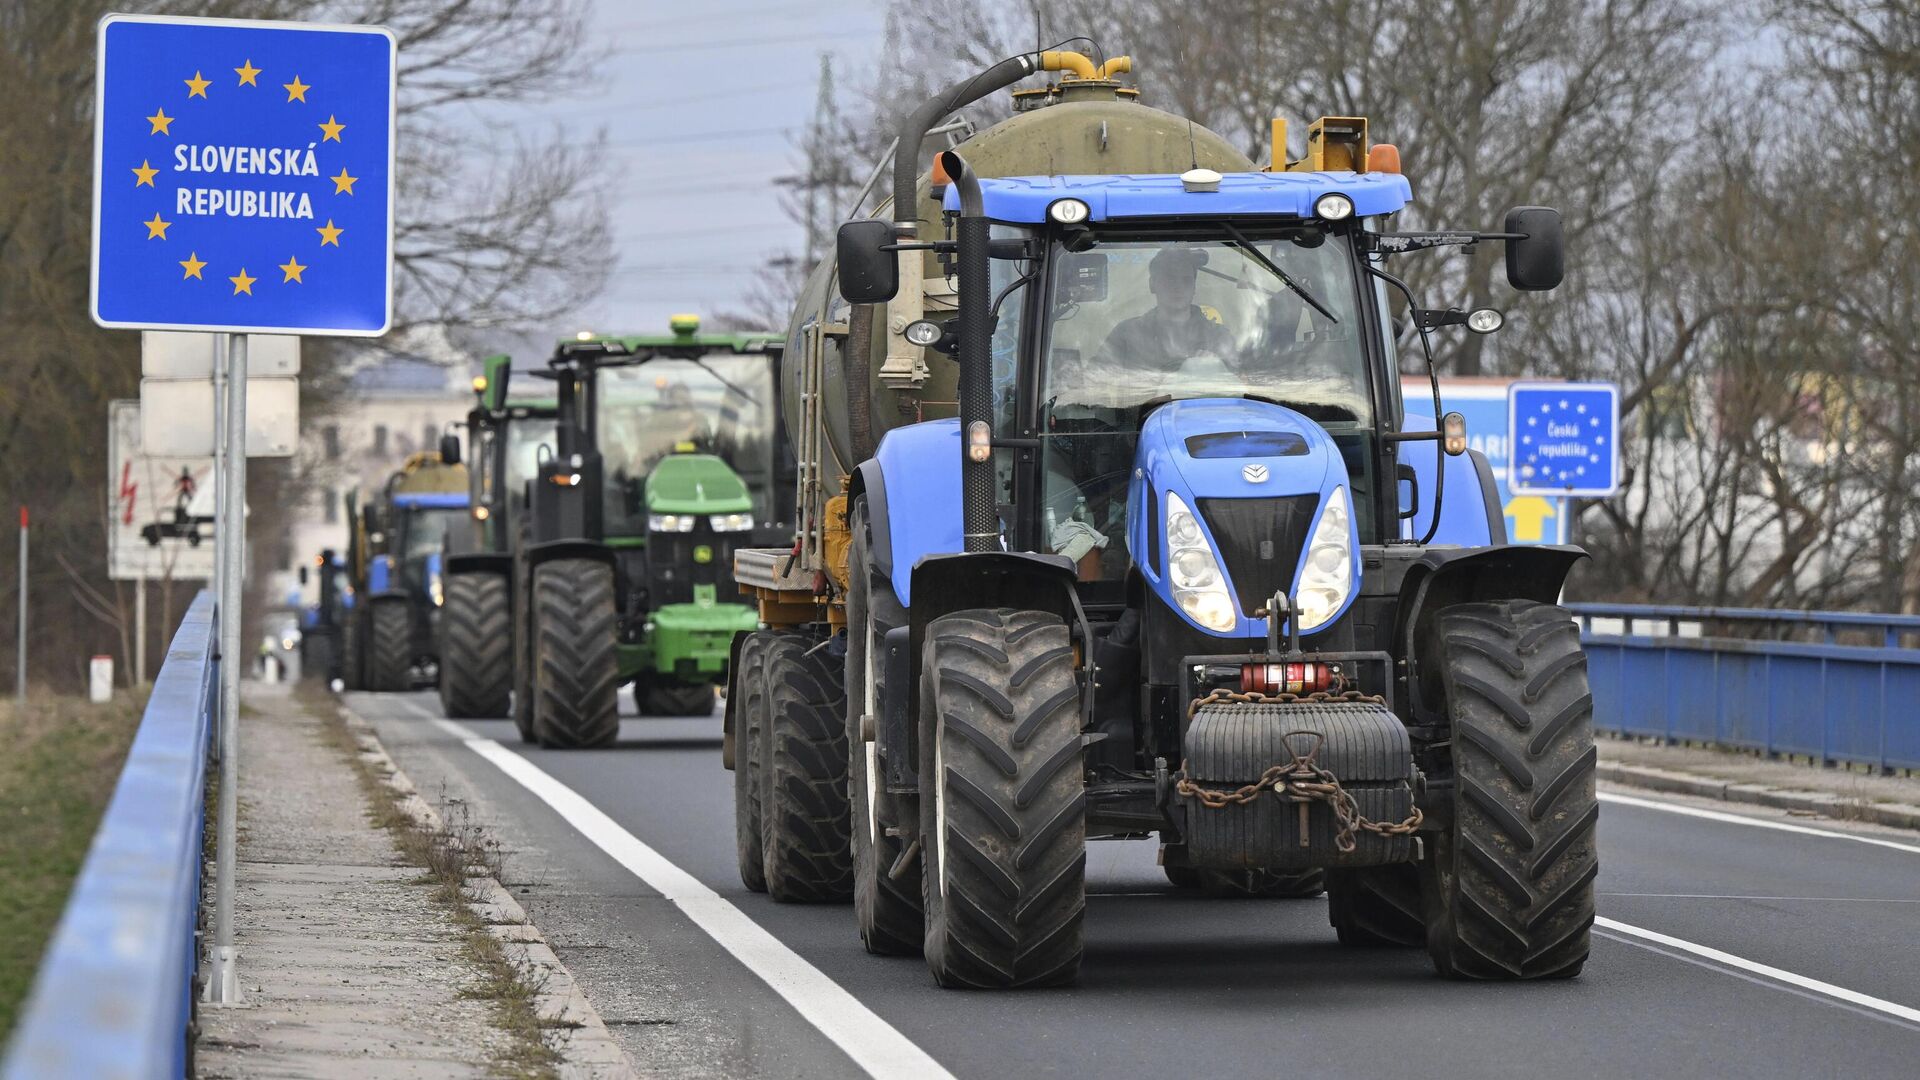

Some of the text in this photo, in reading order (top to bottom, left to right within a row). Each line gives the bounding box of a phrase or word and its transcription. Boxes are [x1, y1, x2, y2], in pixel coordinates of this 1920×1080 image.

[174, 142, 319, 176] SLOVENSKÁ
[176, 187, 314, 219] REPUBLIKA
[1547, 419, 1580, 438] Česká
[1538, 442, 1589, 459] republika
